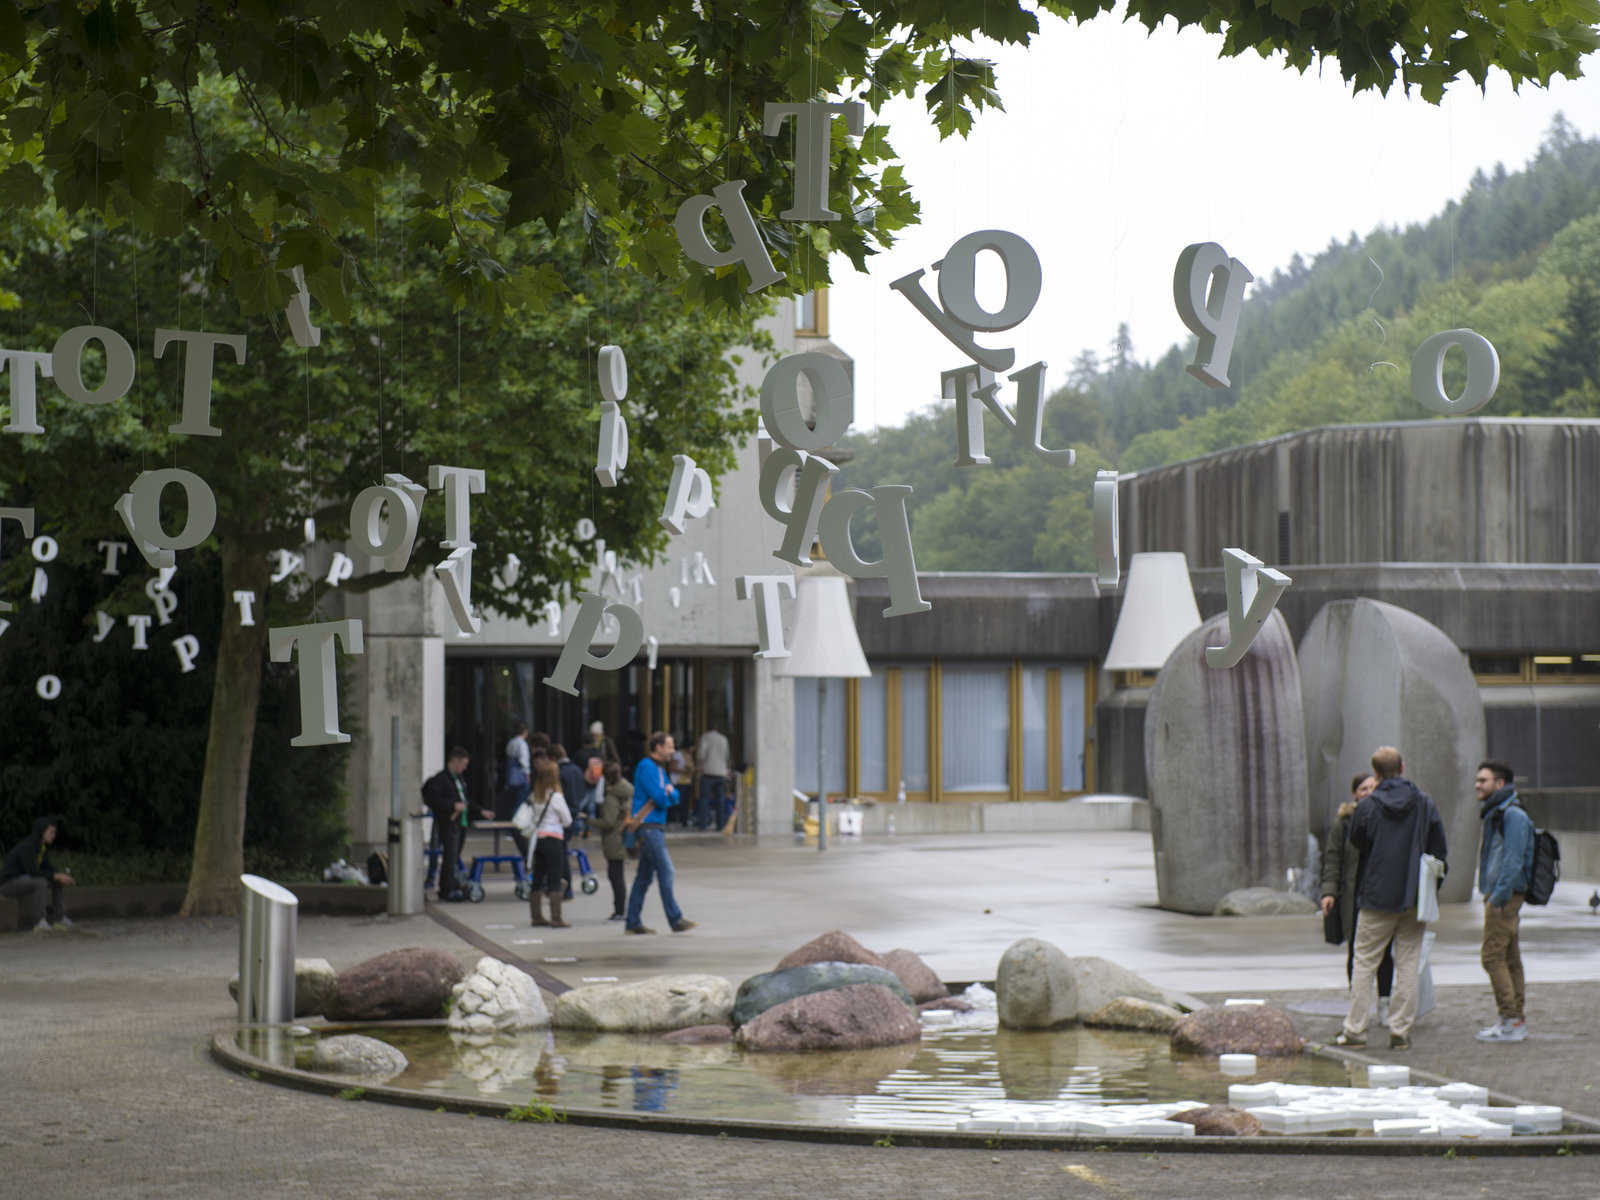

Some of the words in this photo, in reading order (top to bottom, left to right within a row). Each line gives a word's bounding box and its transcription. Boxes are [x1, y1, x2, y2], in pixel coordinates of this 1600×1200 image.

[763, 102, 865, 221] T
[0, 349, 53, 434] T
[154, 328, 247, 437] T
[428, 464, 486, 549] T
[98, 541, 129, 576] T
[271, 548, 303, 584] y
[325, 552, 354, 588] p
[127, 614, 153, 650] T
[233, 590, 256, 626] T
[543, 592, 644, 697] p
[736, 575, 796, 659] T
[1206, 548, 1292, 668] y
[172, 634, 200, 673] p
[269, 618, 364, 747] T
